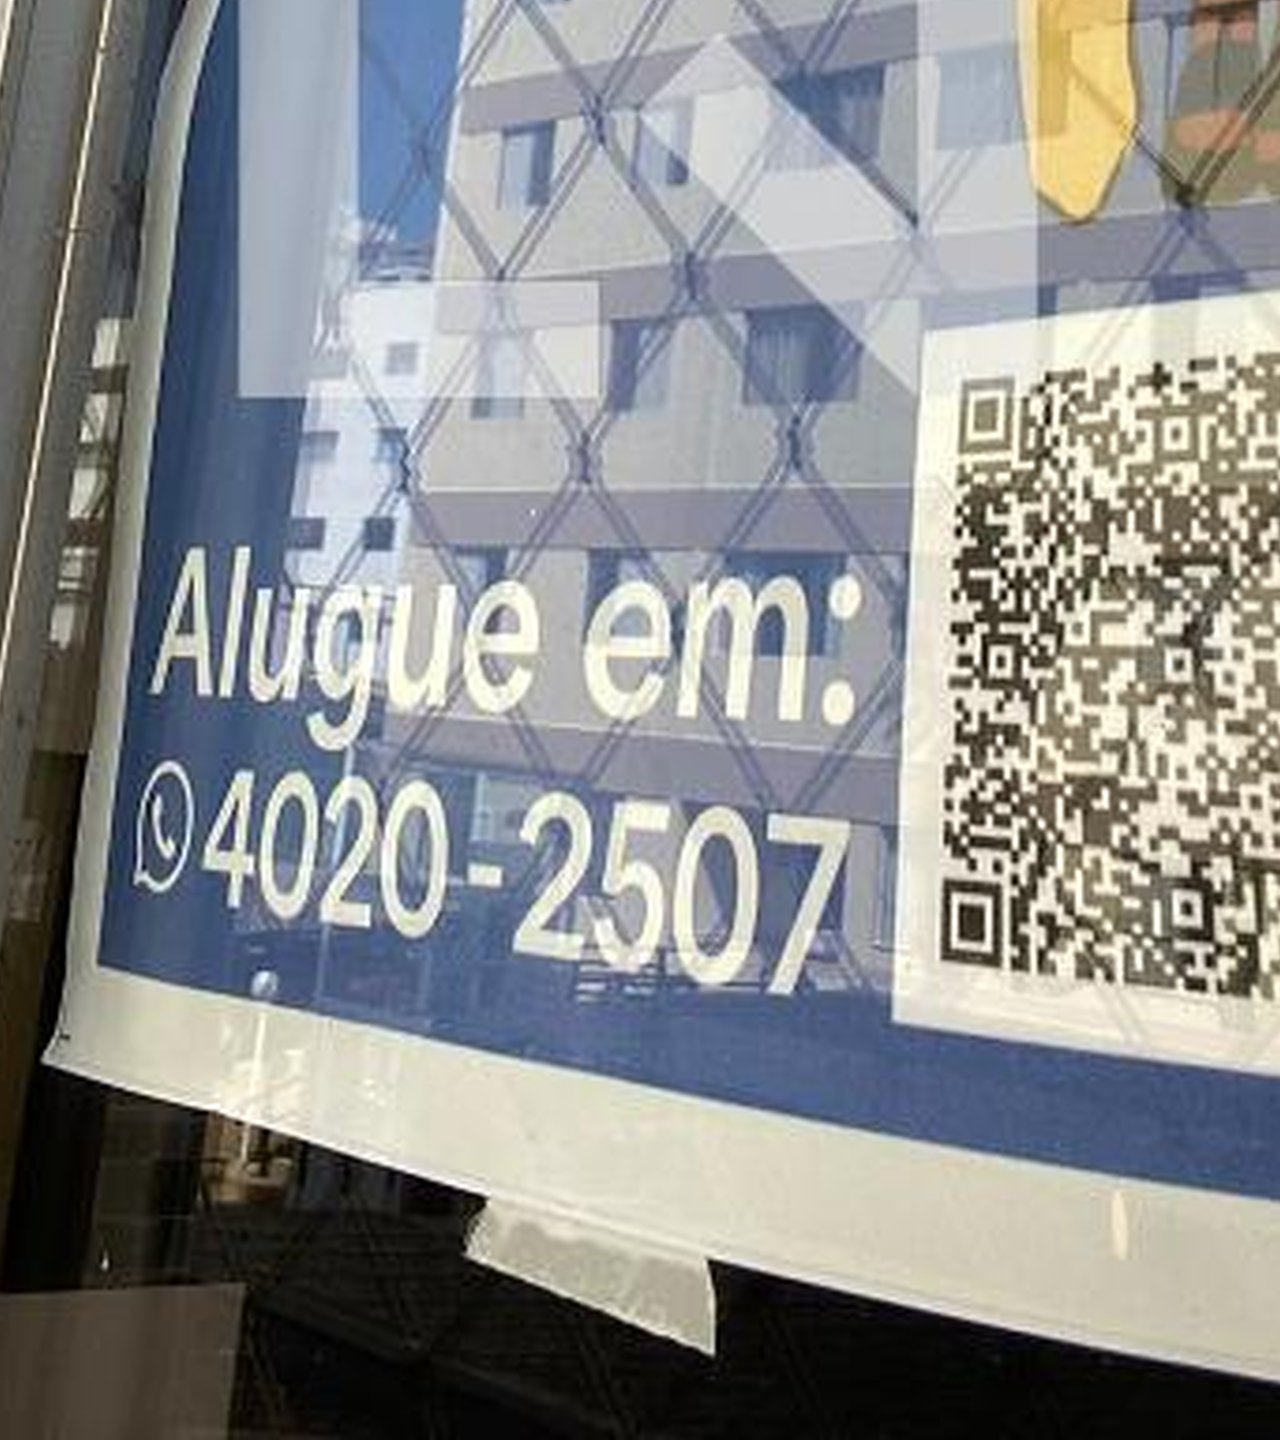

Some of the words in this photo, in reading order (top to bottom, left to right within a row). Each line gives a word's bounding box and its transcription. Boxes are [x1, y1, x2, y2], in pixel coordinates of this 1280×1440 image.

[149, 546, 542, 750] Alugue
[584, 572, 865, 726] em:
[202, 770, 851, 996] 4020-2507
